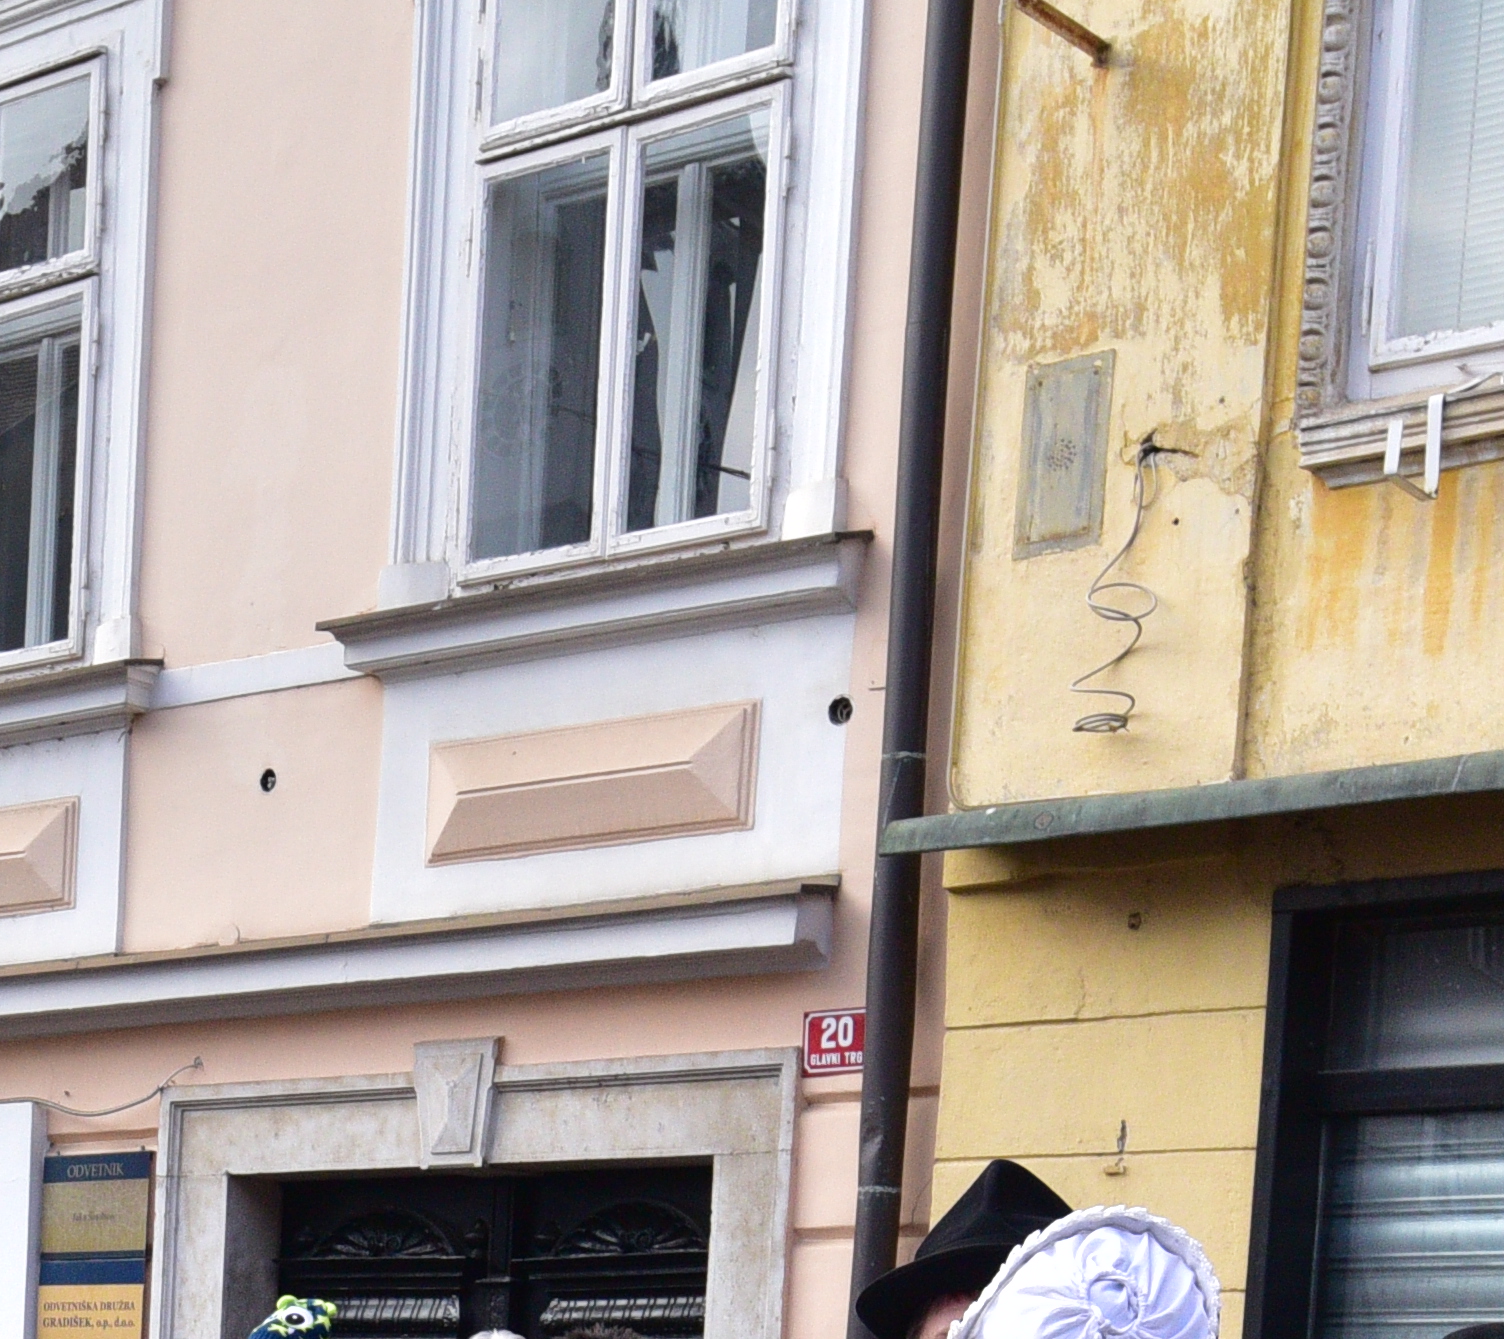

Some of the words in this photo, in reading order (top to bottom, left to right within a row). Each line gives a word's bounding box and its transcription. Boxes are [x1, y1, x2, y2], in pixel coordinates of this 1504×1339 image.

[821, 1016, 853, 1049] 20
[810, 1052, 841, 1065] GLAVNI
[844, 1051, 863, 1064] TRG
[67, 1163, 124, 1178] ODVETNIK
[43, 1301, 98, 1312] ODVETNIŠKA
[100, 1299, 135, 1311] DRUŽBA
